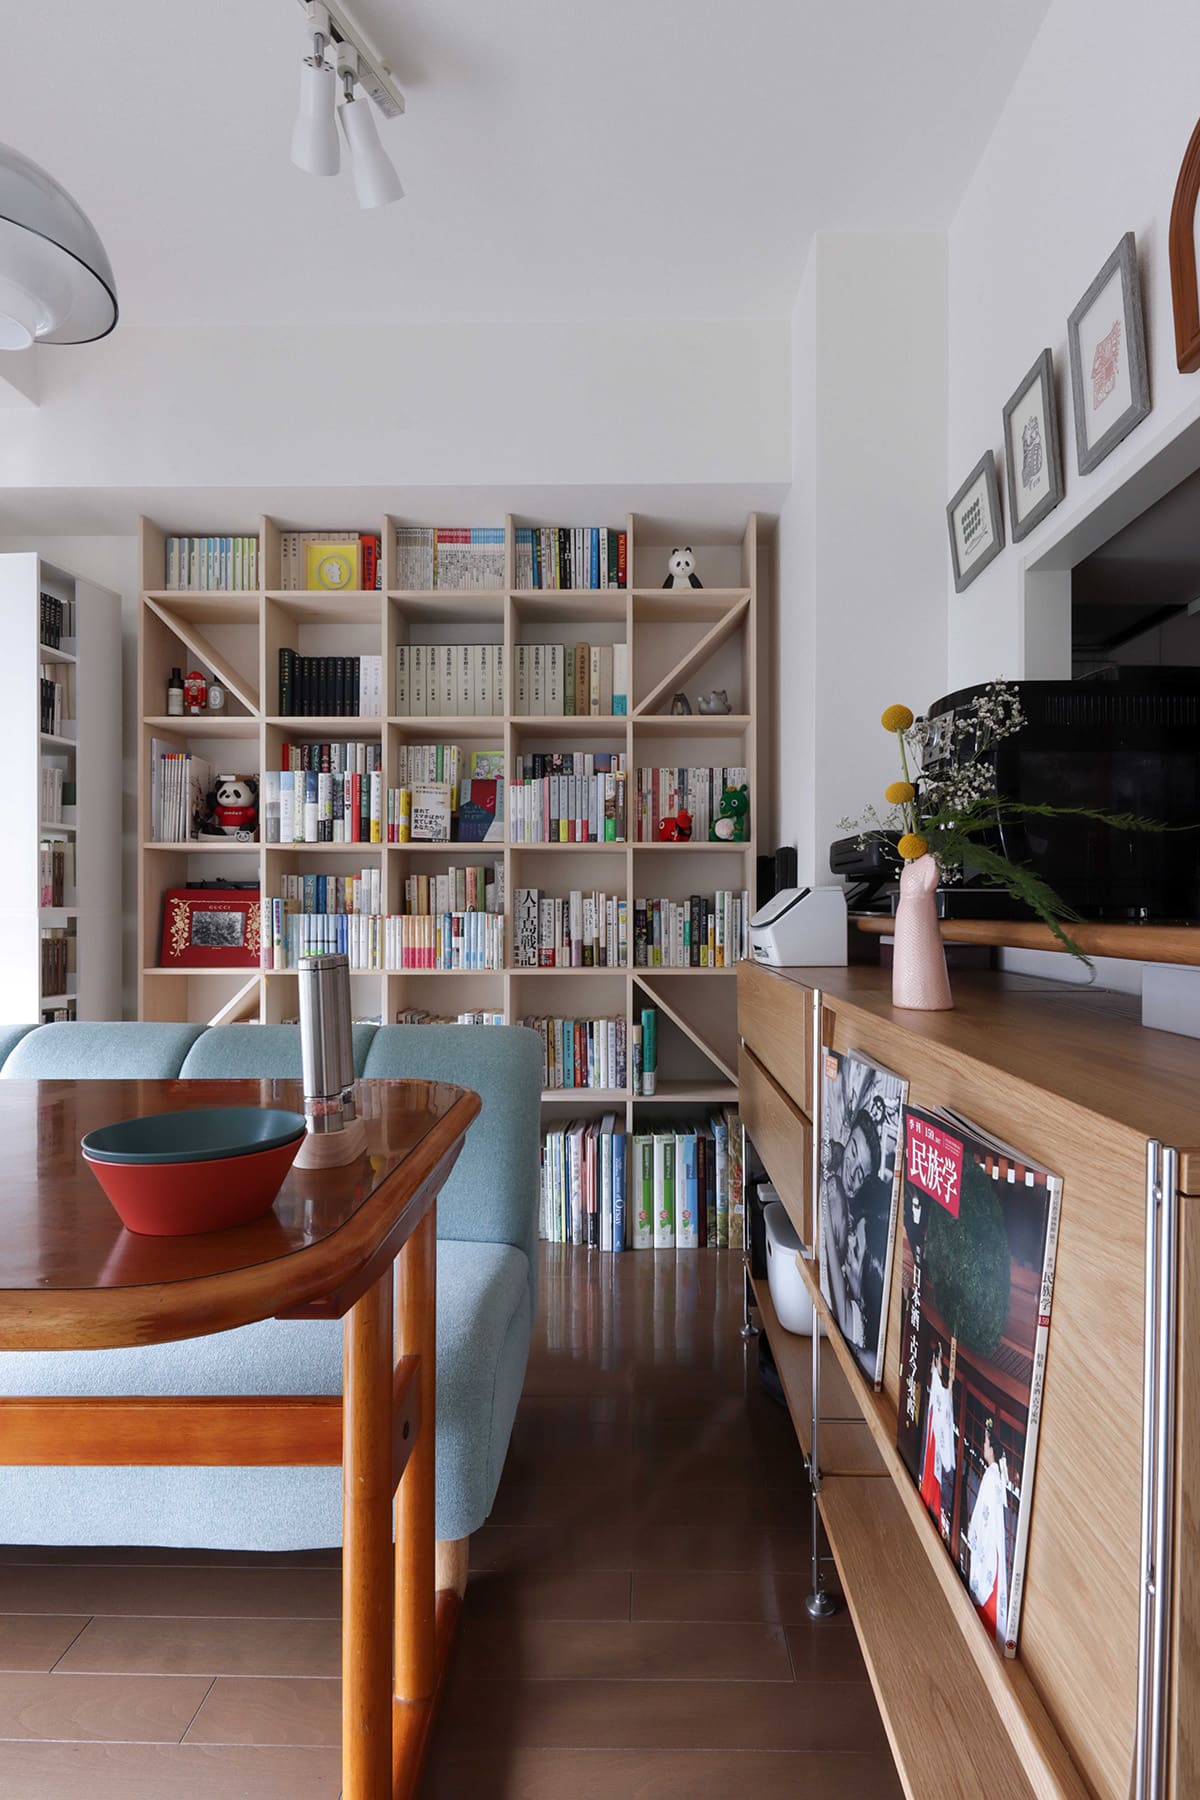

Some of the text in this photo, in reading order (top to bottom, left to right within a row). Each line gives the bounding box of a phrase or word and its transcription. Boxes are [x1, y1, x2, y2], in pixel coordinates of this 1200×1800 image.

[910, 1137, 957, 1203] 民族学
[1040, 1272, 1054, 1311] 民族学
